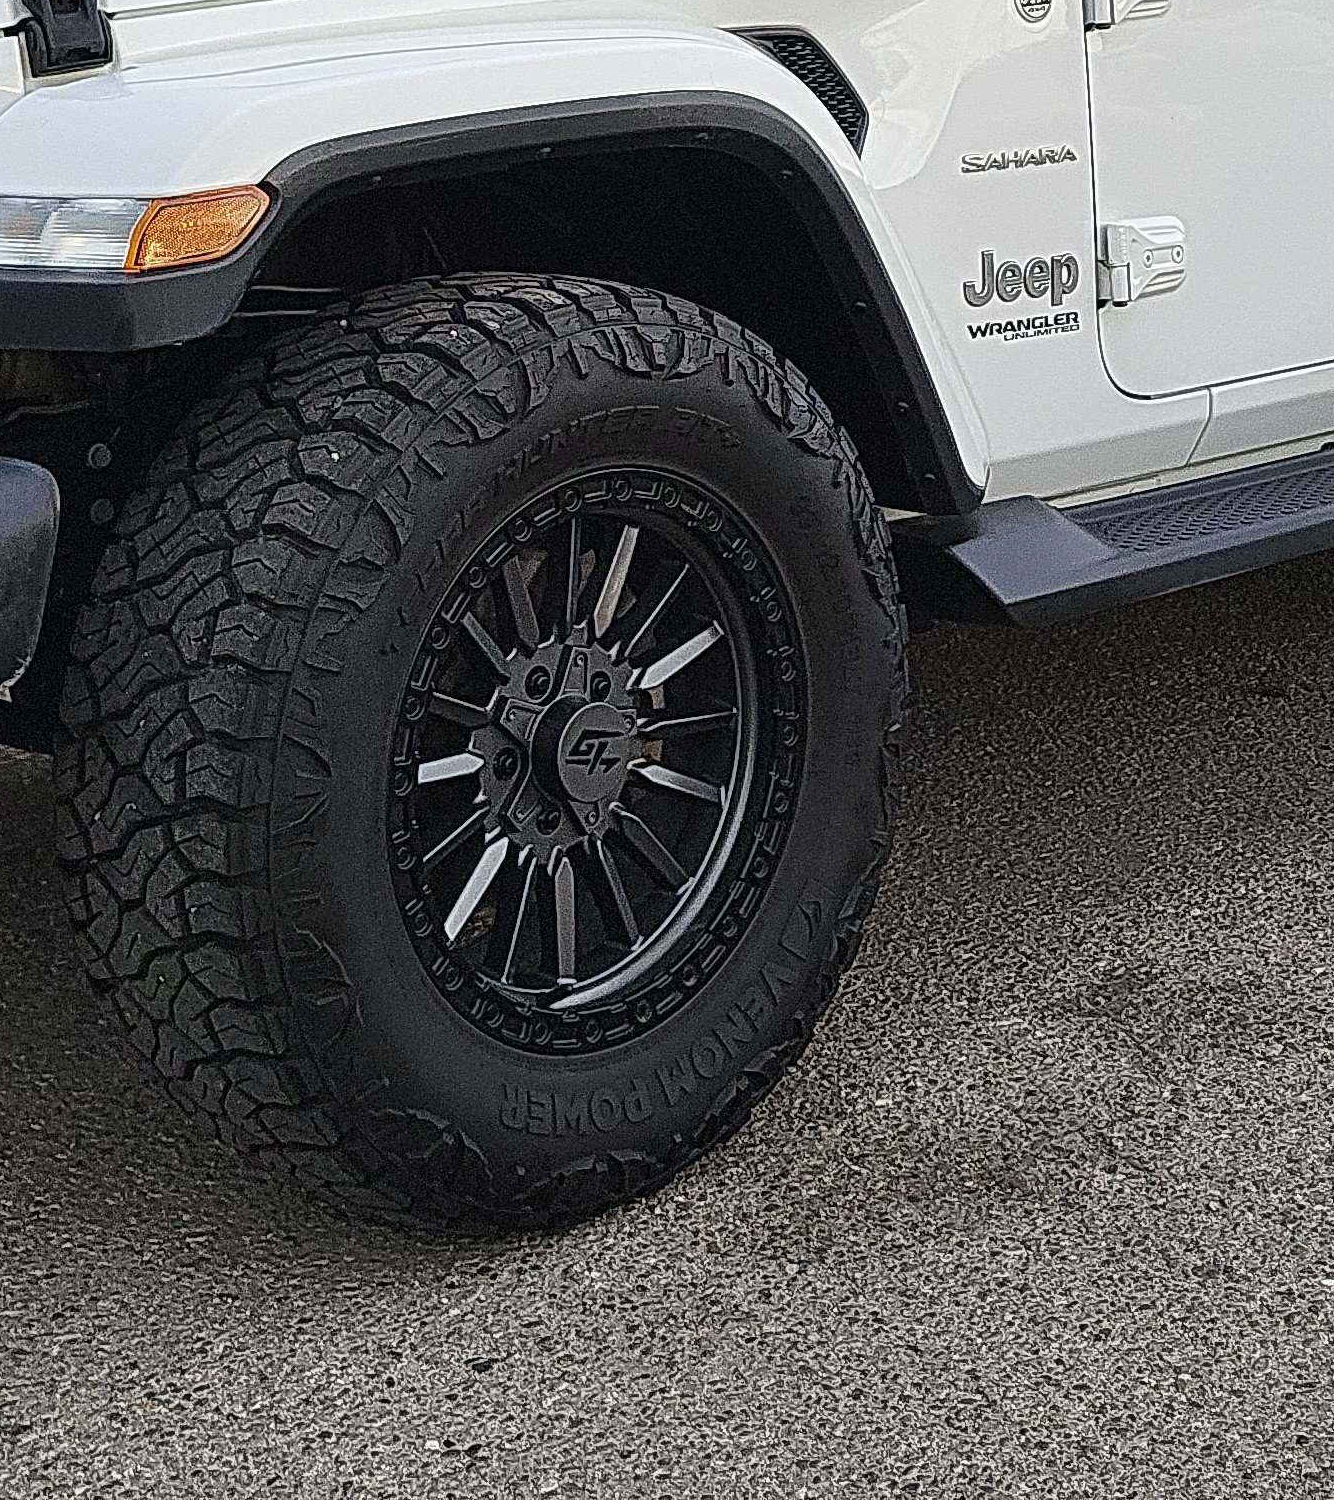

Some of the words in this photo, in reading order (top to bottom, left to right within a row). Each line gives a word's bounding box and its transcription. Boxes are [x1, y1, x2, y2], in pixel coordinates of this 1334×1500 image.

[961, 145, 1077, 174] SAHARA
[963, 250, 1079, 307] Jeep
[967, 311, 1079, 339] WRANGLER
[1004, 323, 1079, 341] UNLIMITED
[654, 959, 803, 1108] VENOM
[498, 1080, 654, 1137] POWER
